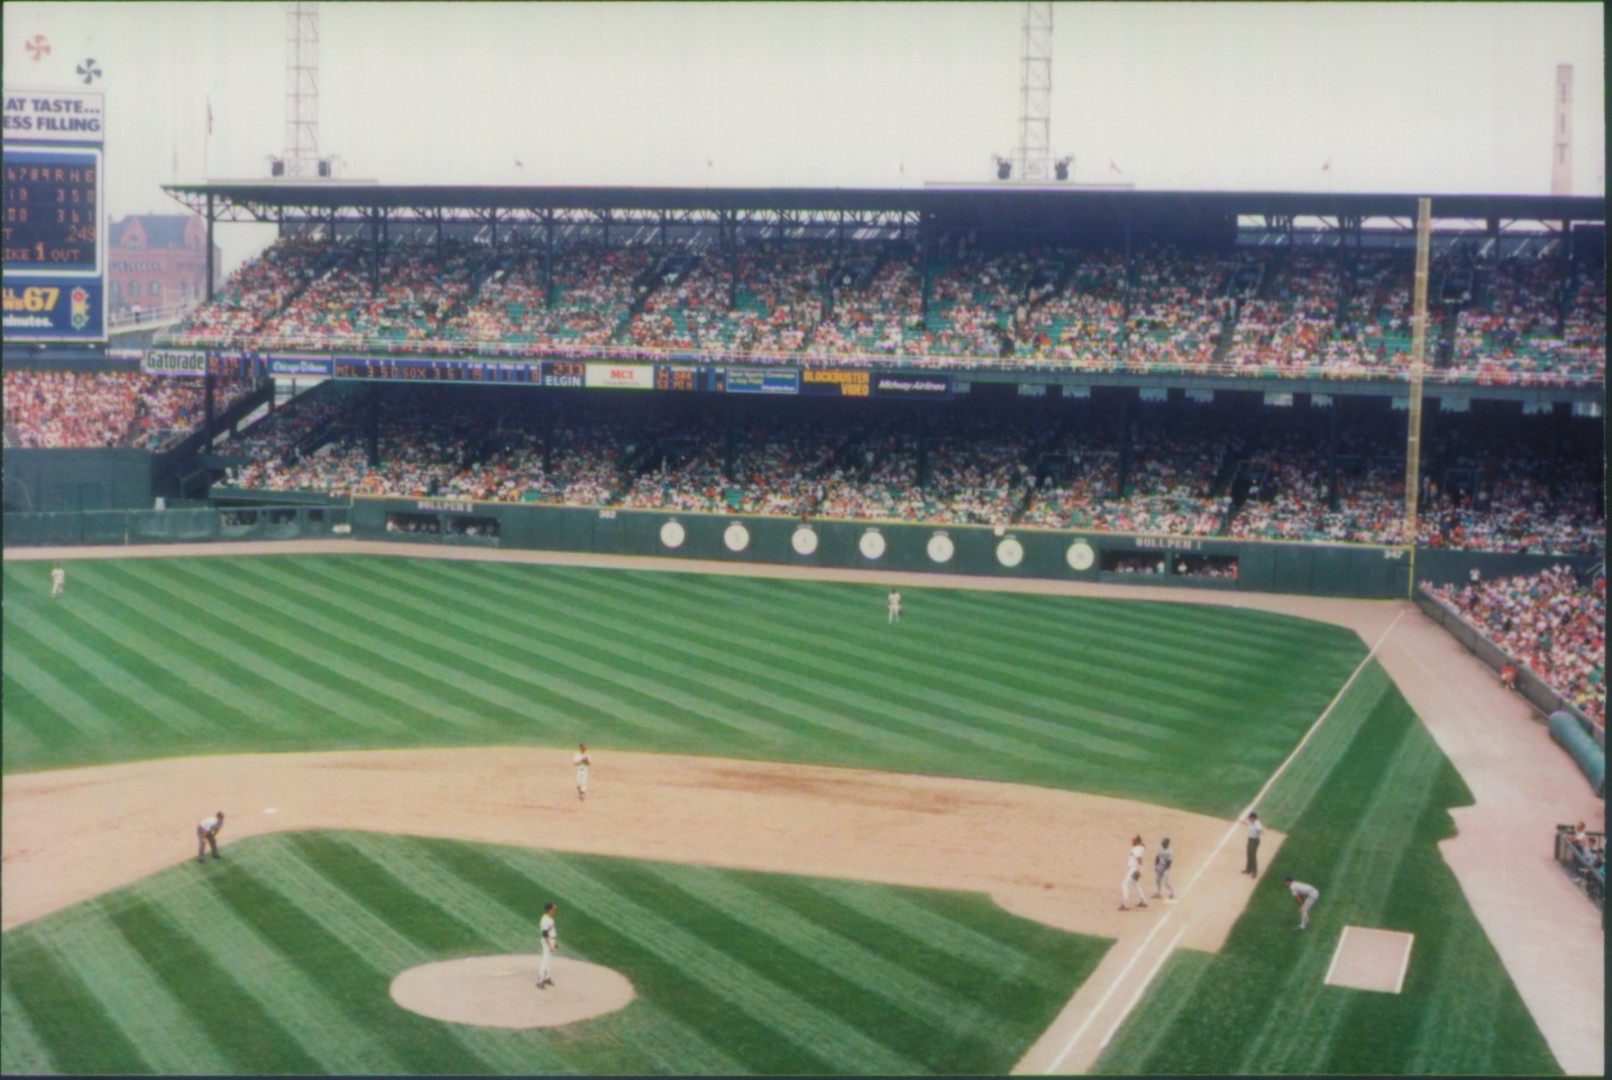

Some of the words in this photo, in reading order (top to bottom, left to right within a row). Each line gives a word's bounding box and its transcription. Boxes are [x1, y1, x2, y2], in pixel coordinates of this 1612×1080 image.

[36, 117, 100, 132] FILLING
[35, 241, 45, 261] 1
[50, 248, 80, 261] OUT
[24, 287, 59, 311] 67
[147, 352, 204, 370] Gatorade
[402, 367, 426, 379] SOX
[610, 369, 634, 379] MCI
[803, 371, 869, 384] BLOCKBUSTER
[545, 375, 581, 386] ELGIN
[878, 380, 911, 392] Midway
[911, 382, 946, 392] Airlines
[841, 384, 869, 396] VIDEO
[417, 500, 464, 512] BULLPEN
[1135, 537, 1191, 550] BULLPEN
